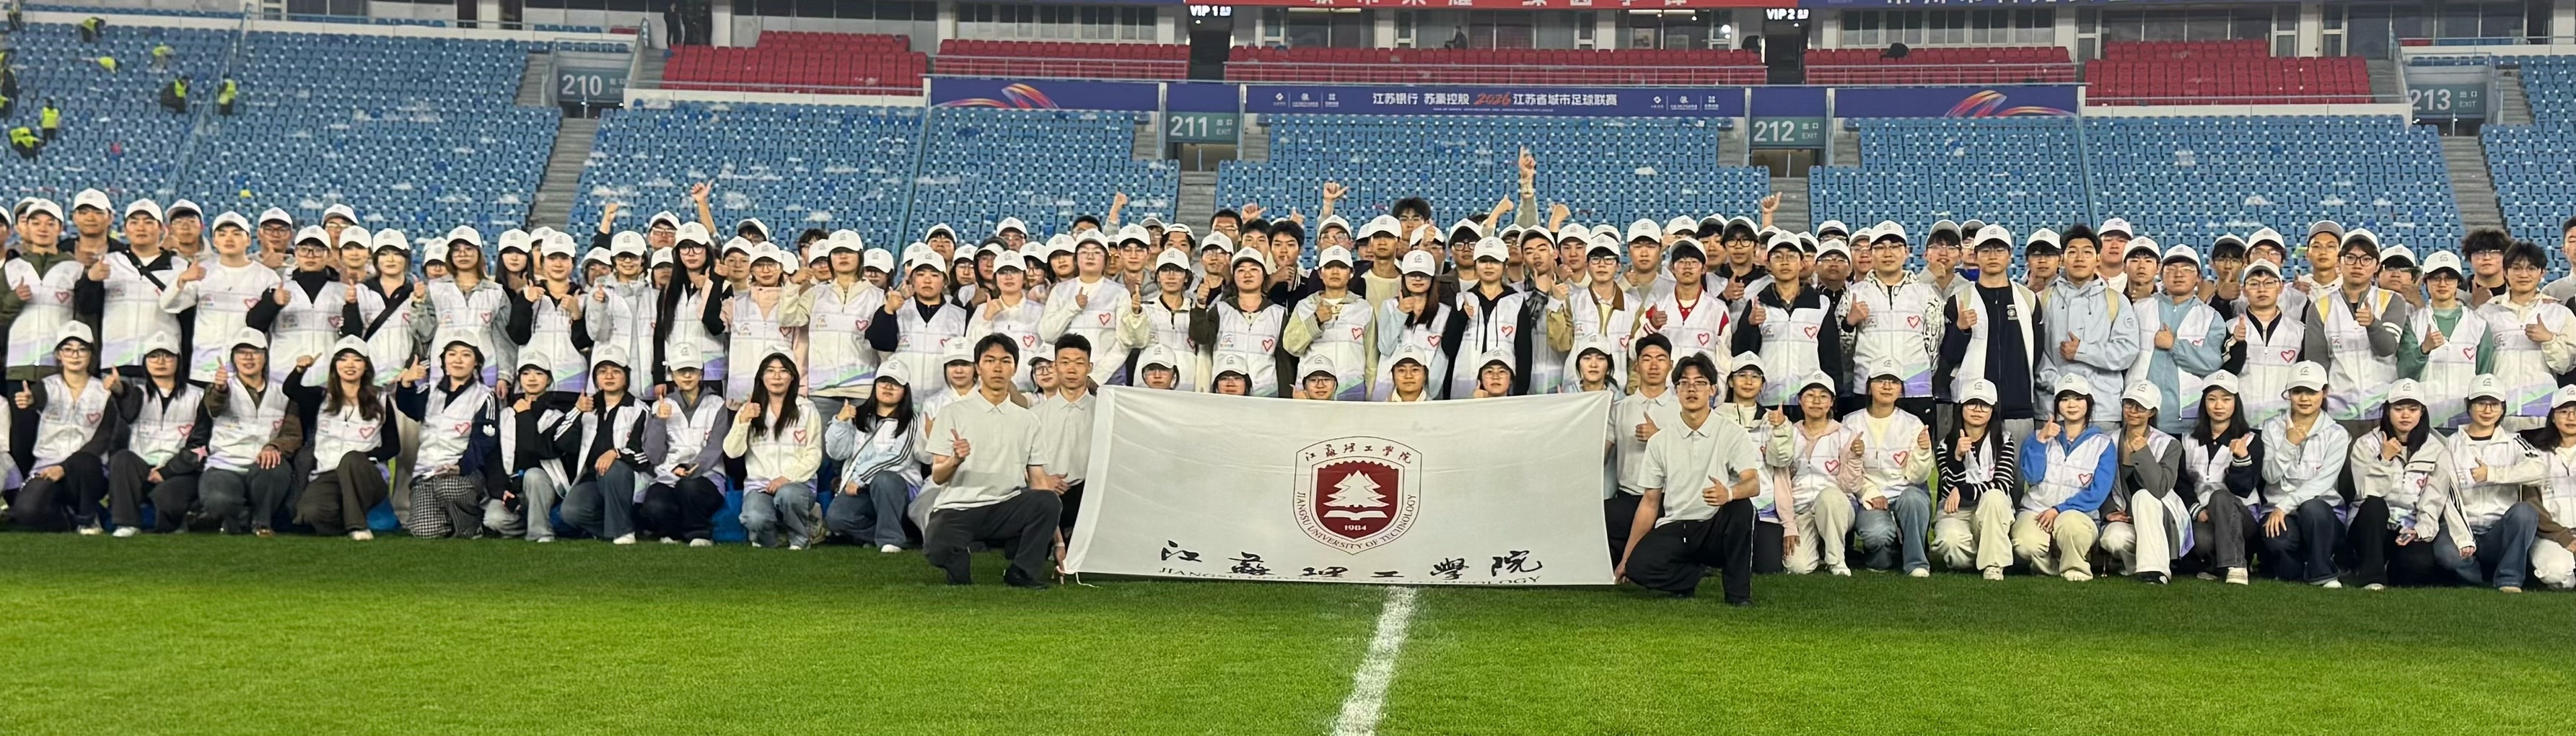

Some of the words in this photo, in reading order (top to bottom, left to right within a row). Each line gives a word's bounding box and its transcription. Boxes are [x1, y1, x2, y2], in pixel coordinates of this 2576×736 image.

[562, 74, 602, 96] 210
[1372, 92, 1418, 105] 江苏银行
[1473, 92, 1511, 106] 2026
[1513, 93, 1617, 105] 江苏省城市足球联赛
[2410, 89, 2451, 110] 213
[1170, 115, 1207, 137] 211
[1754, 121, 1795, 141] 212
[1297, 491, 1310, 526] JIANGSU
[1307, 525, 1363, 549] UNIVERSITY
[1365, 539, 1378, 548] OF
[1379, 494, 1416, 543] TECHNOLOGY
